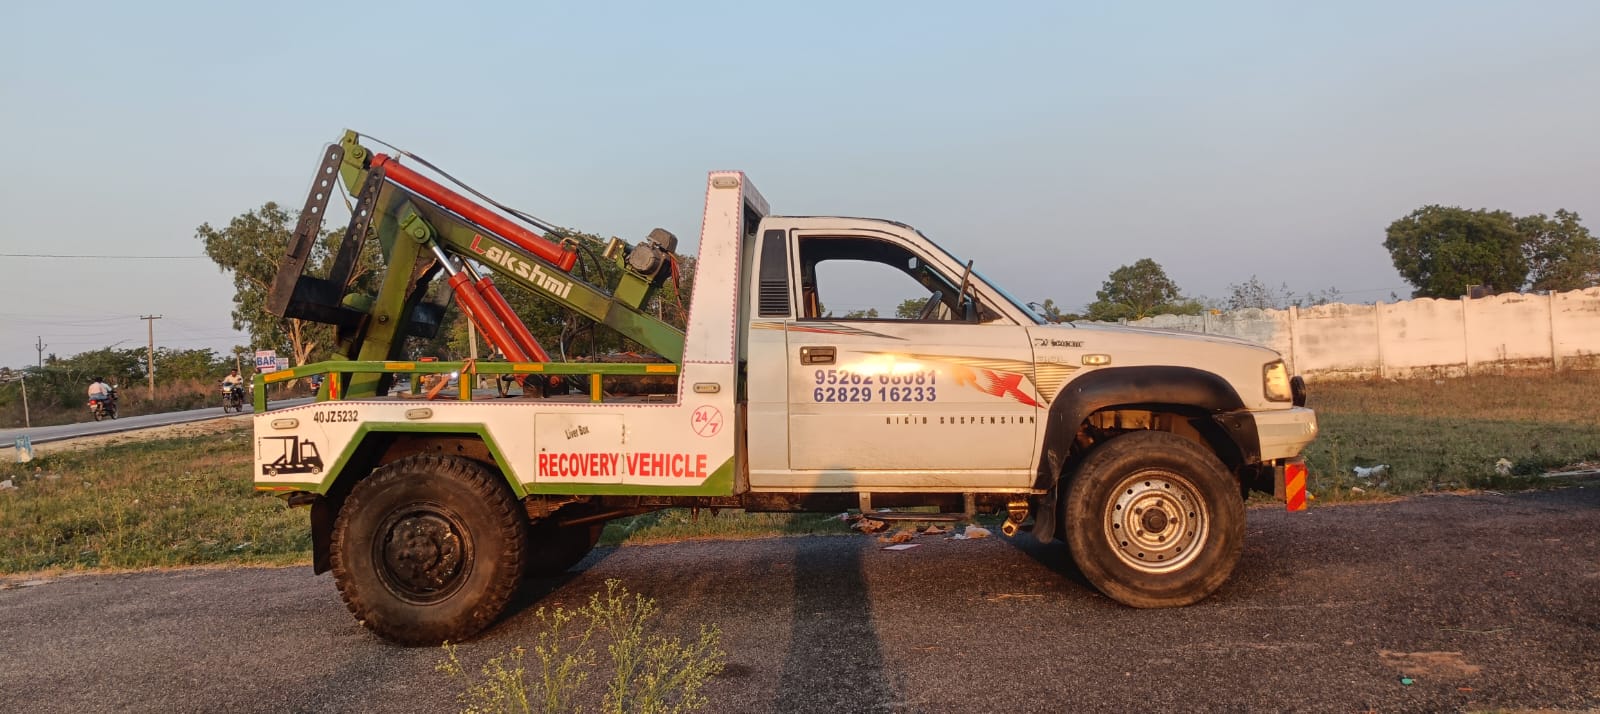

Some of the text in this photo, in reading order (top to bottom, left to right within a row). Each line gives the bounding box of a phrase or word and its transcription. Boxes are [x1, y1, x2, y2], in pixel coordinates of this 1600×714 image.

[469, 233, 573, 299] Lakshmi
[256, 356, 276, 366] BAR
[813, 386, 937, 402] 62829 16233
[313, 410, 359, 423] 40JZ5232
[886, 416, 1035, 425] RIGID SUSPENSION
[578, 425, 590, 436] Box
[538, 453, 708, 478] RECOVERY VEHICLE
